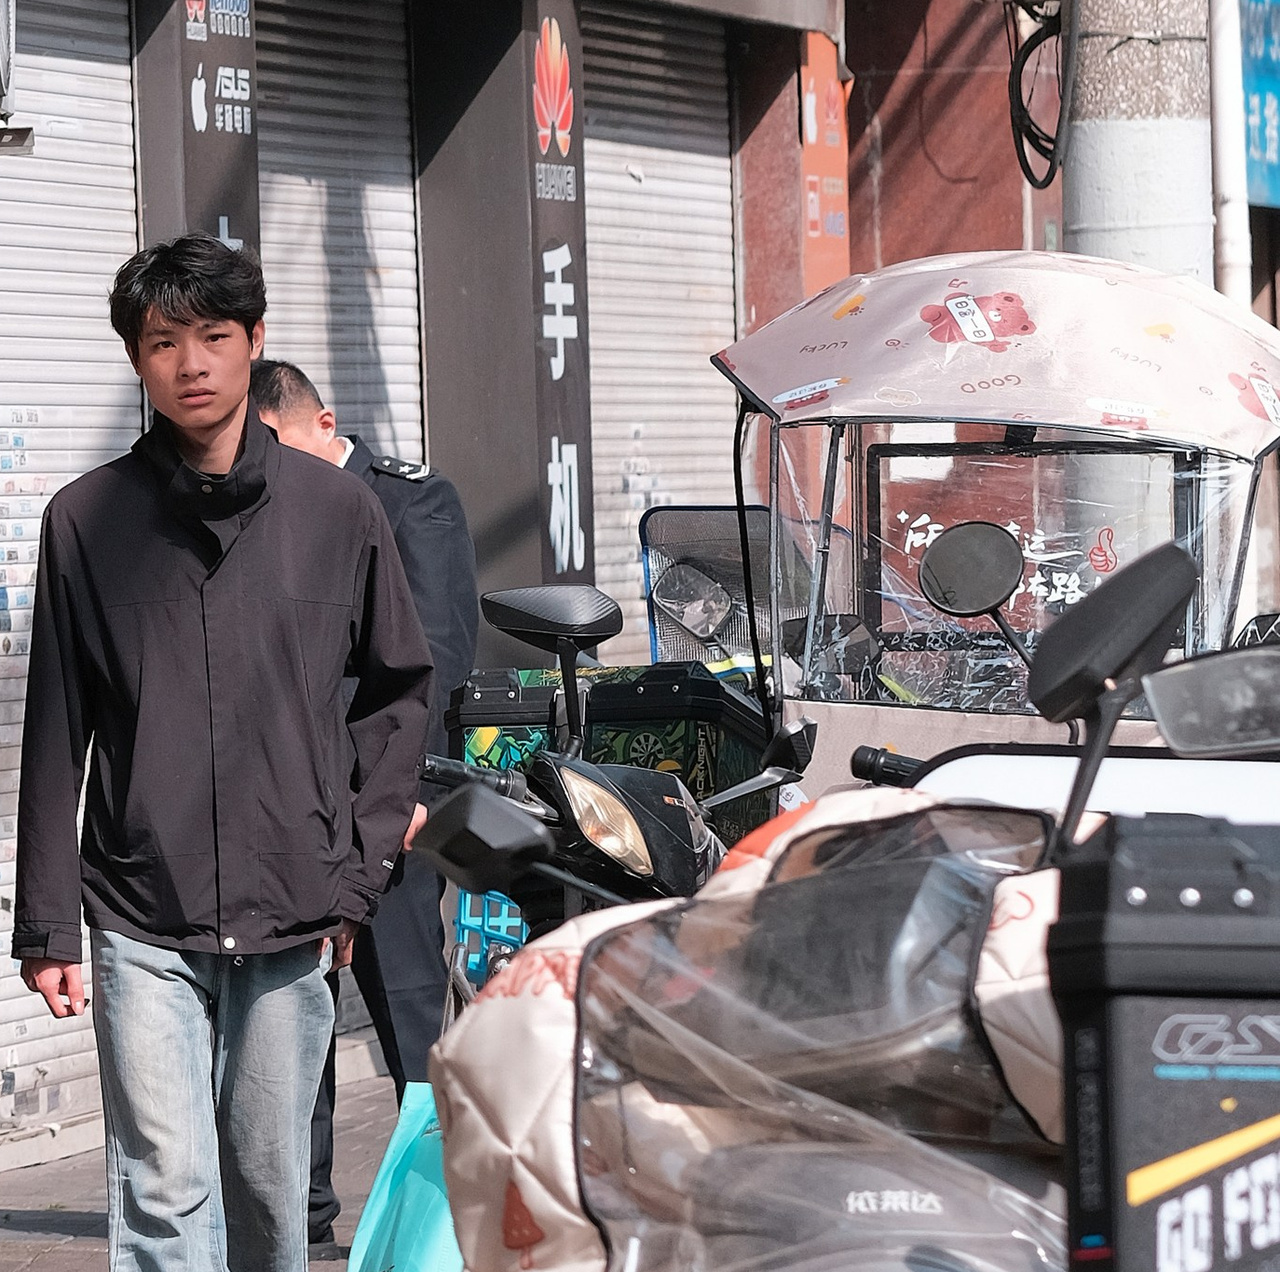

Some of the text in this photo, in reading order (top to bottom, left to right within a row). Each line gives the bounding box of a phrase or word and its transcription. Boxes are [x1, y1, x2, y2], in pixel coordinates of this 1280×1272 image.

[961, 374, 1022, 394] GOOD
[845, 1189, 944, 1215] 依莱达
